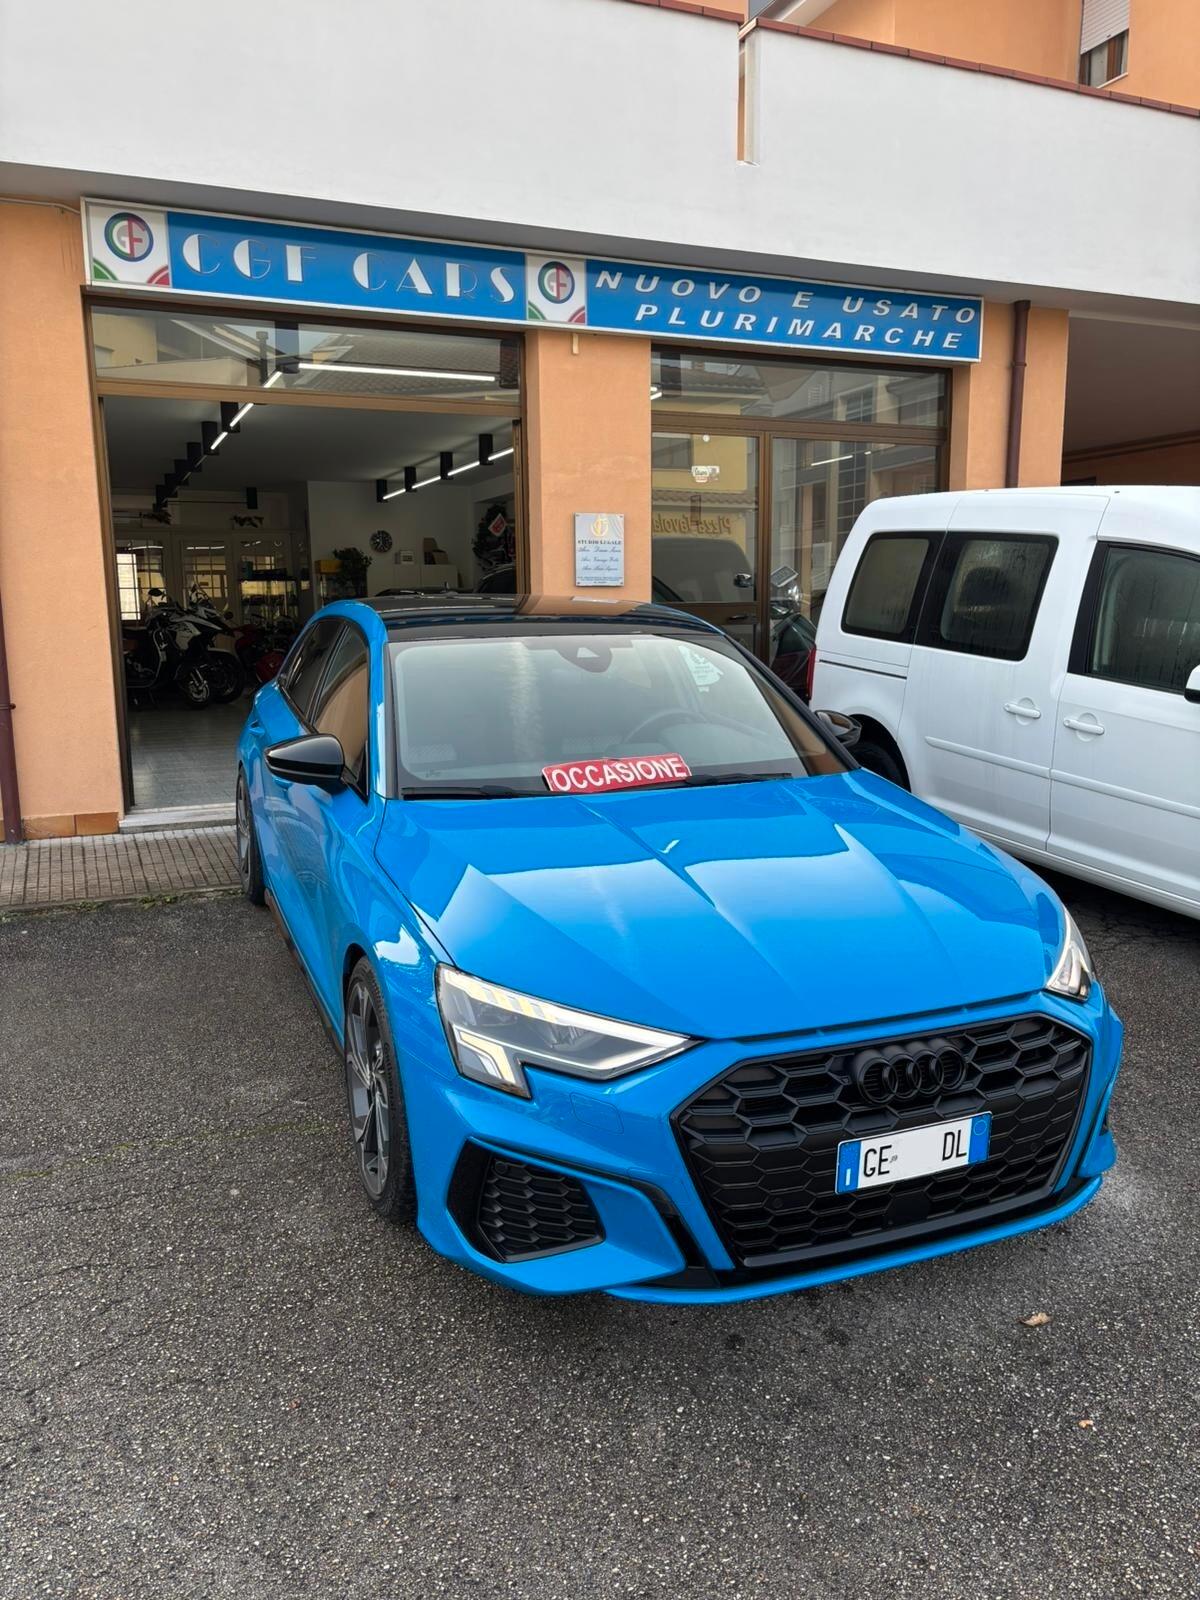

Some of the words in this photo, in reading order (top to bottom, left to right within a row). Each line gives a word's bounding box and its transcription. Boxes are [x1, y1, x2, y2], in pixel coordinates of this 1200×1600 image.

[182, 233, 317, 282] CGF
[352, 251, 517, 304] CARS
[595, 270, 762, 304] NUOVO
[792, 291, 814, 309] E
[842, 295, 976, 324] USATO
[635, 303, 963, 350] PLURIMARCHE
[551, 757, 688, 792] OCCASIONE
[863, 1144, 892, 1178] GE
[941, 1129, 967, 1162] DL
